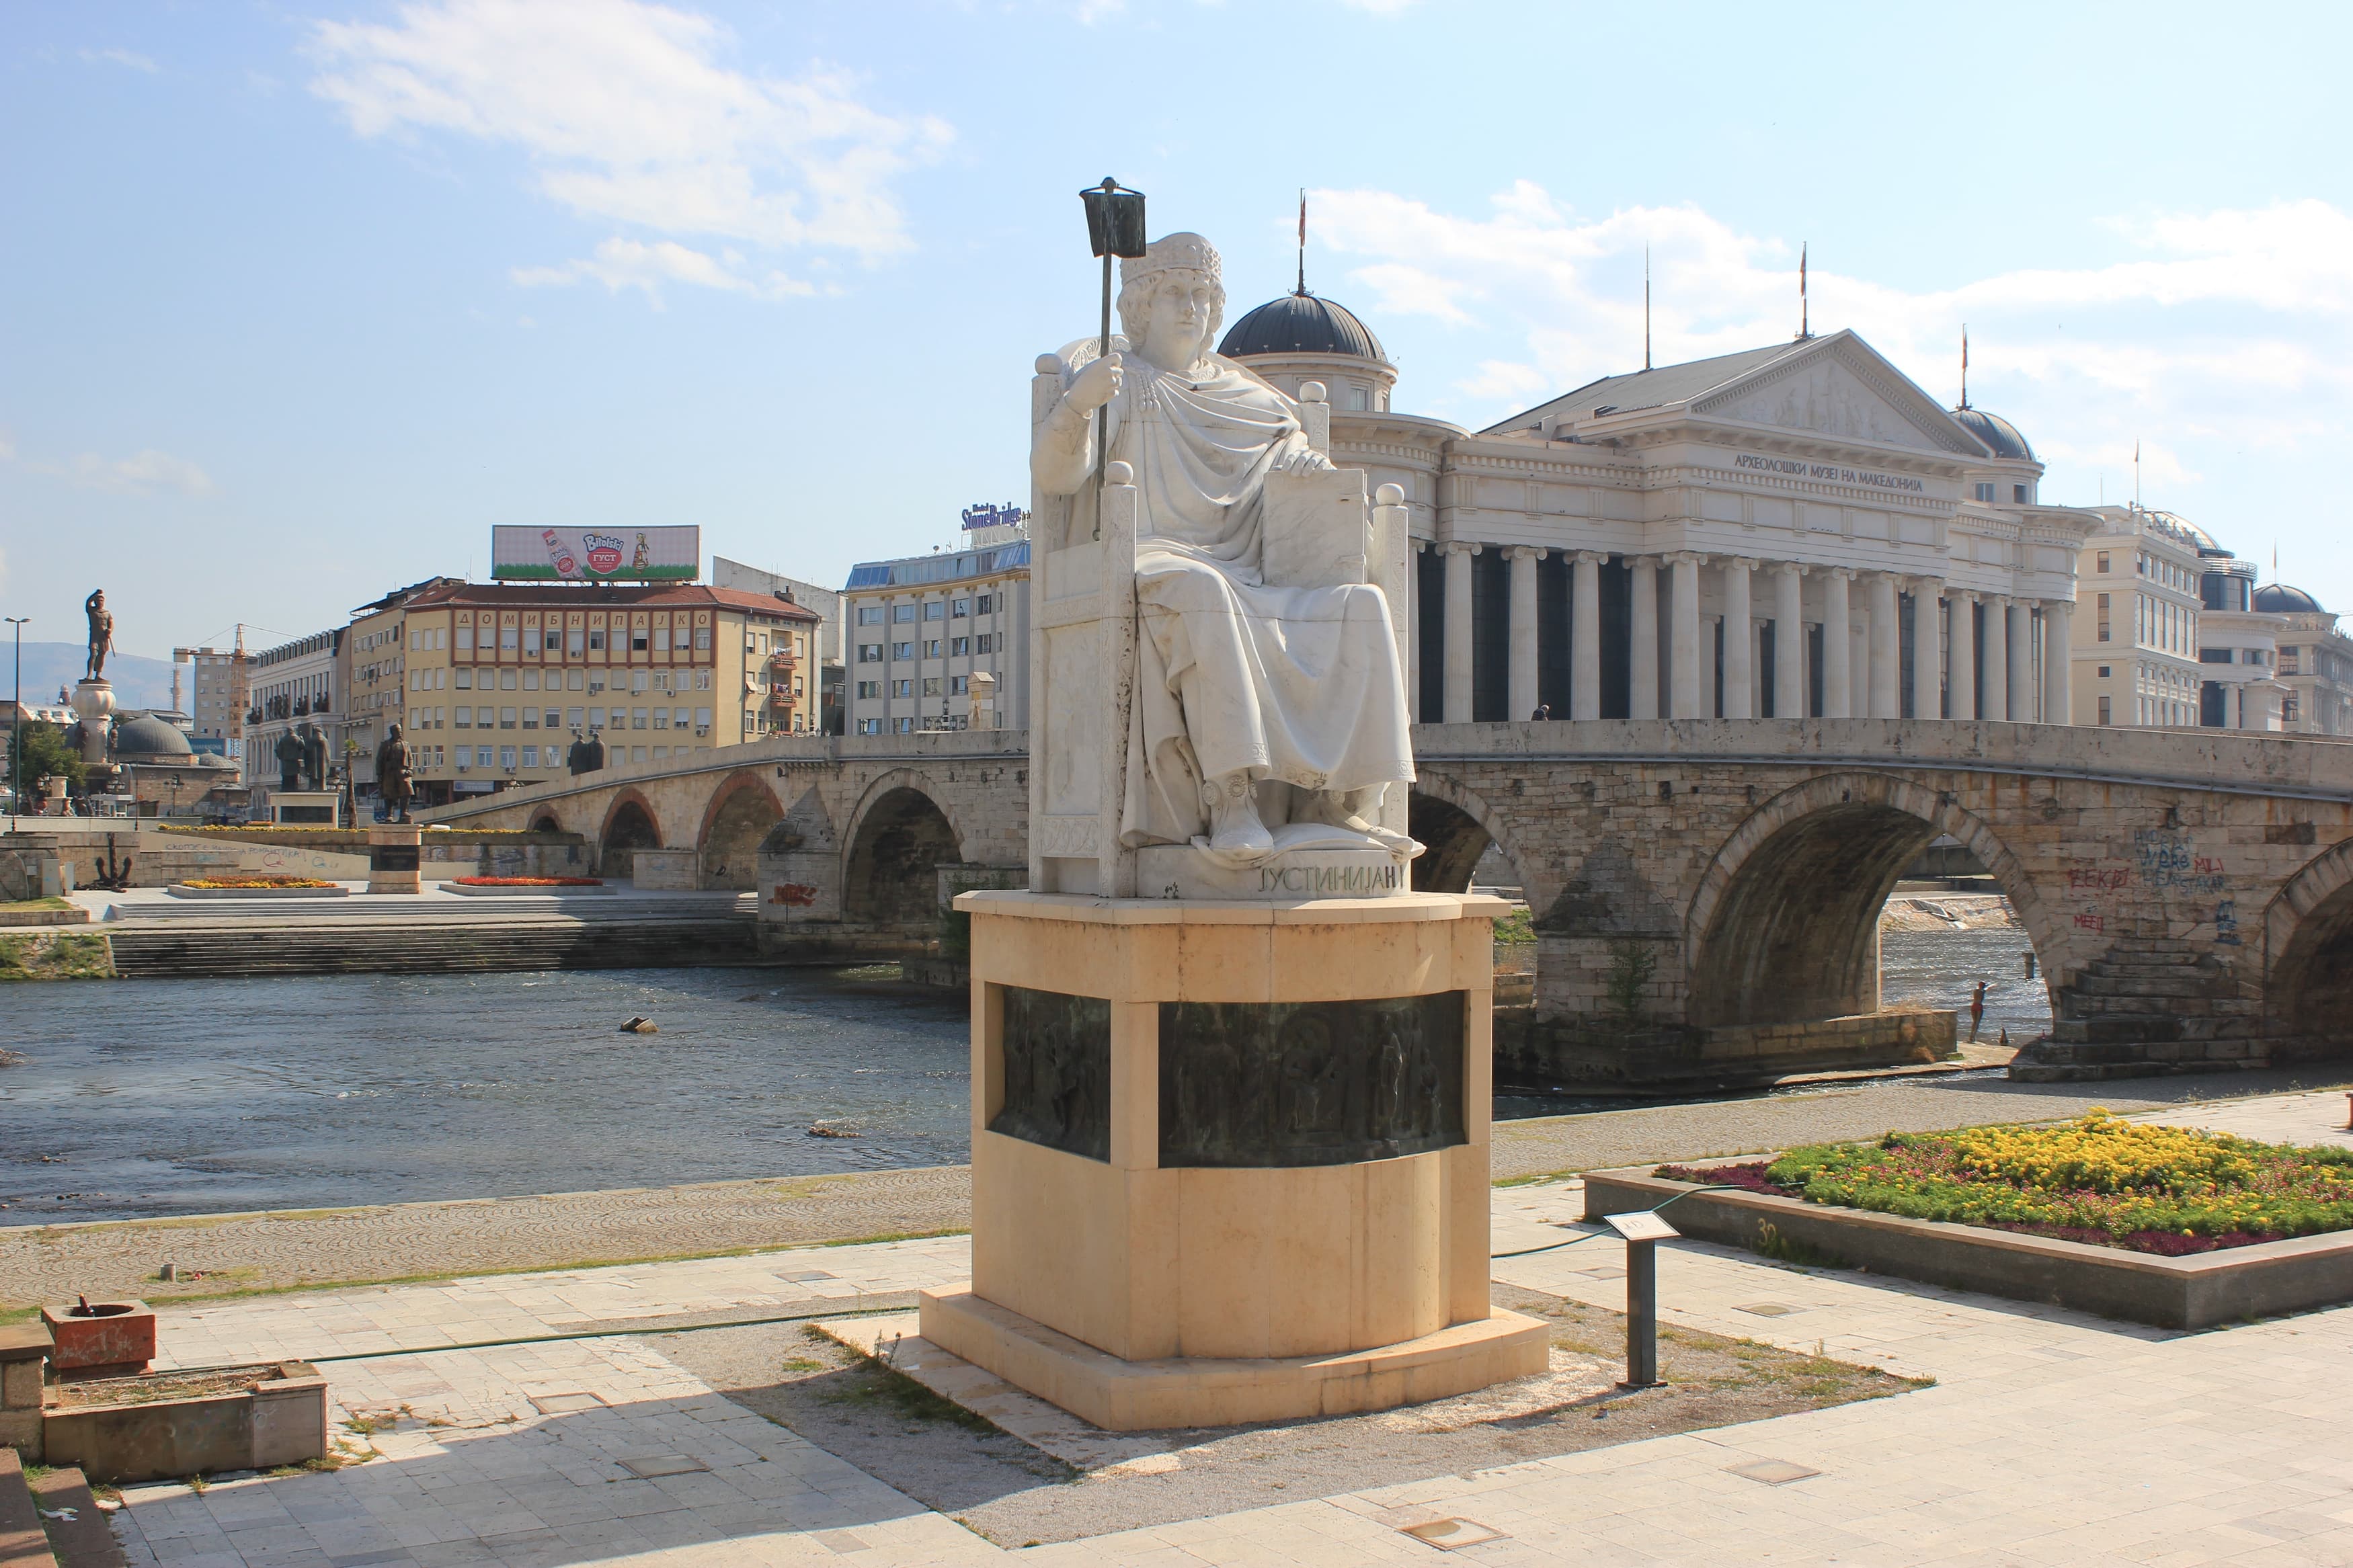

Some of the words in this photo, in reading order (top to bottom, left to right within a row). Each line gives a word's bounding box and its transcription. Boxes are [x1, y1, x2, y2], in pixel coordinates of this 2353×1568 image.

[1735, 455, 1806, 476] АРХЕОЛОШКИ
[1810, 465, 1837, 480] МУЗЕЈ
[1841, 469, 1856, 483] НА
[1859, 472, 1923, 492] МАКЕДОНИЈА
[584, 534, 624, 552] Bitolski
[1259, 866, 1396, 892] ЈУСТИНИЈАН
